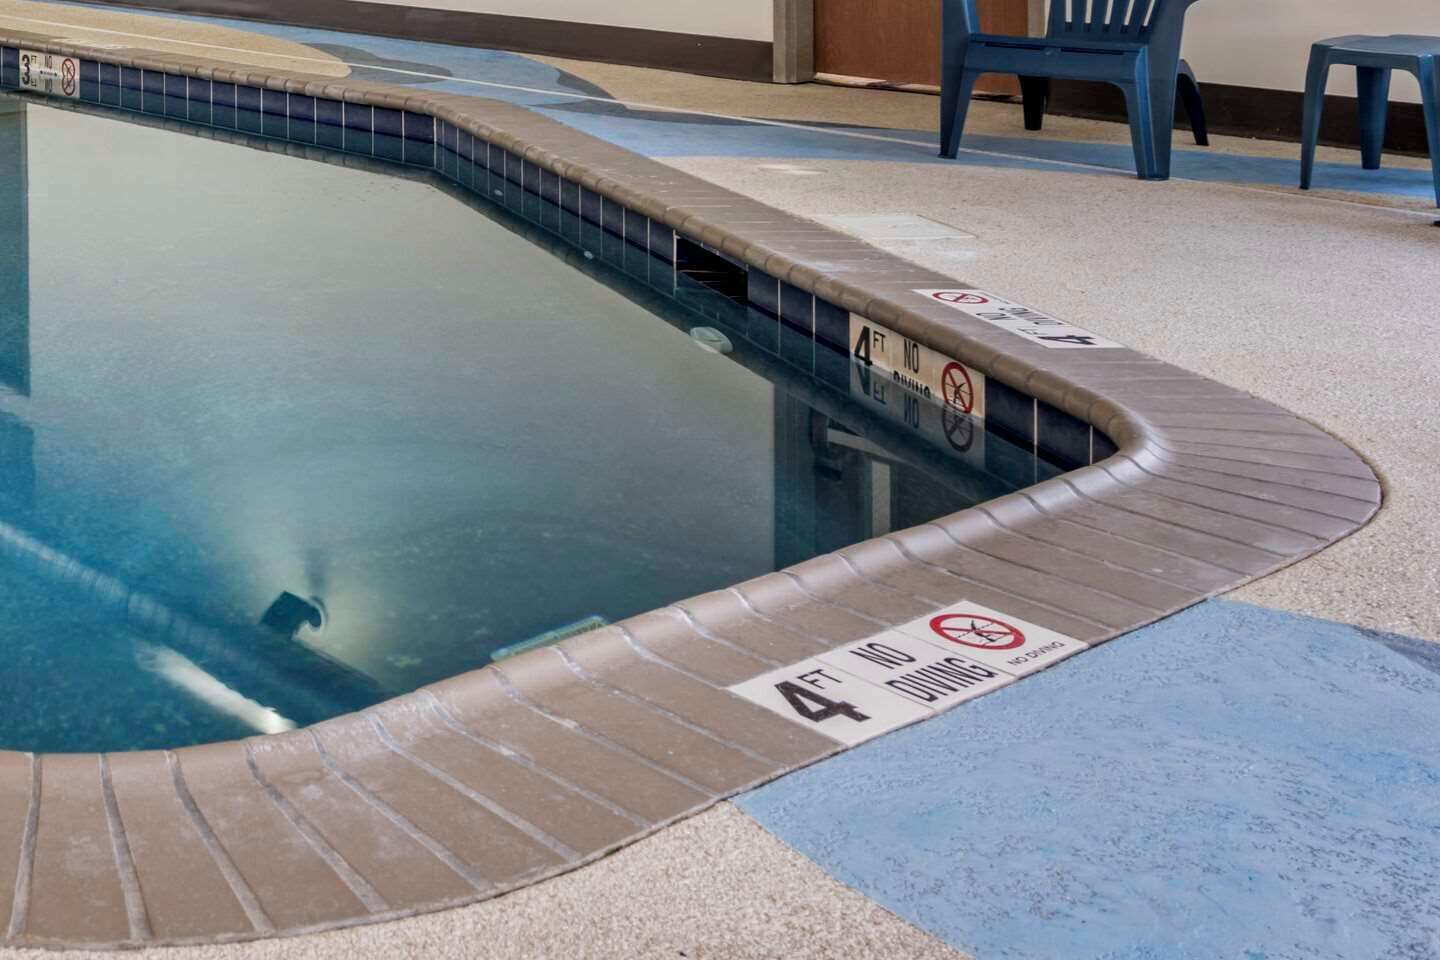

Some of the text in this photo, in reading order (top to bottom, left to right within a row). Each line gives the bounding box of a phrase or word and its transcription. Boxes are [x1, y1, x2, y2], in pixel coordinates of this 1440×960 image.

[22, 54, 37, 71] 3 FT
[855, 326, 886, 366] 4 FT
[904, 338, 919, 374] NO
[848, 642, 917, 670] NO
[1009, 640, 1066, 667] NO DIVING
[774, 669, 872, 723] 4 FT
[885, 656, 998, 703] DIVING
